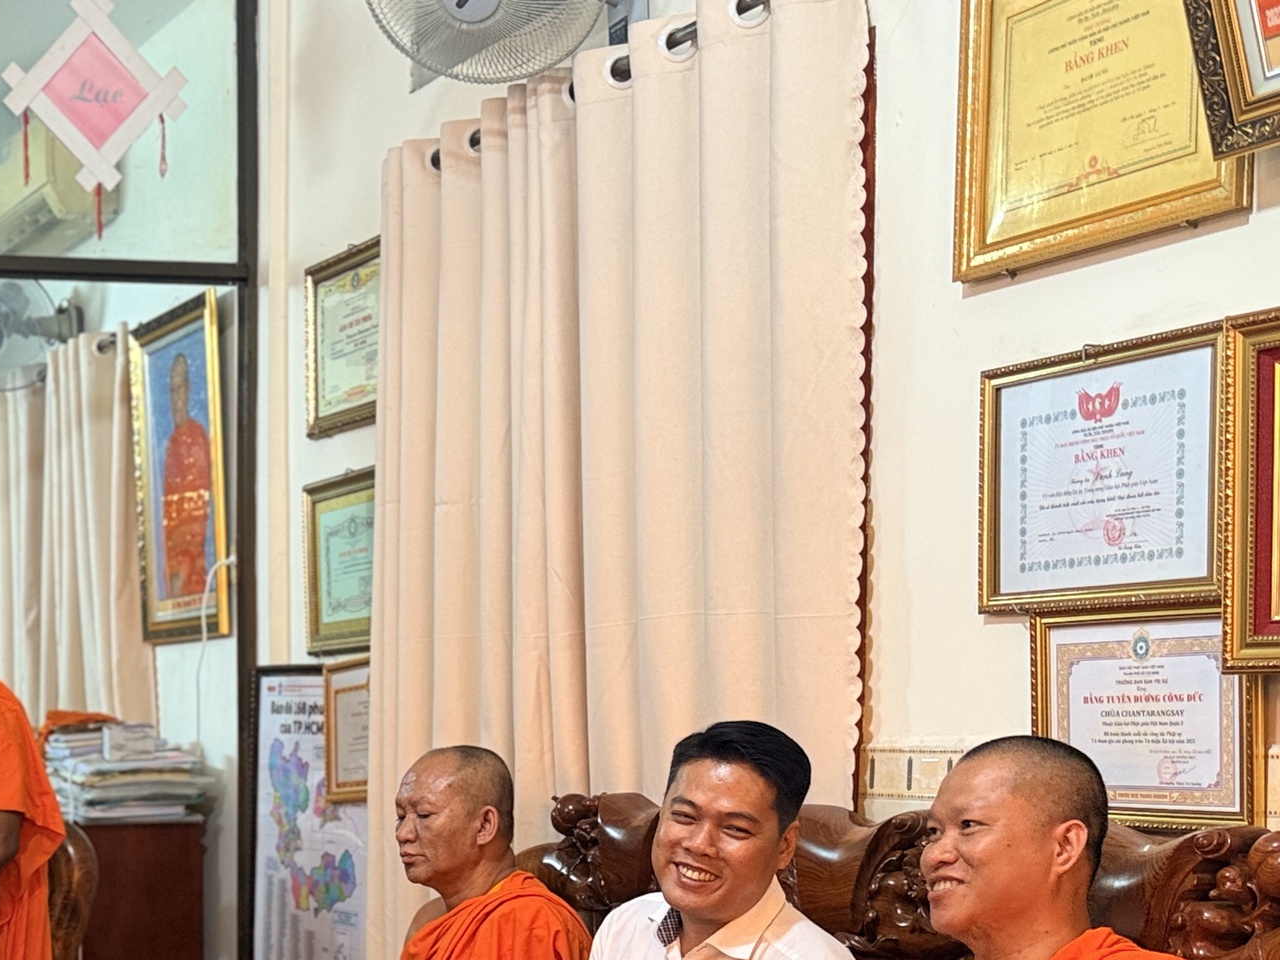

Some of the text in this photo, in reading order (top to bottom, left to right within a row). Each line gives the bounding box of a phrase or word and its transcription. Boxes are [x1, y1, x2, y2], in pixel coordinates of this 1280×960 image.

[1065, 51, 1094, 73] BẰNG
[1097, 37, 1130, 61] KHEN
[1074, 446, 1125, 464] BẰNG KHEN
[1083, 691, 1104, 705] BẰNG
[1133, 692, 1161, 704] DƯƠNG
[1162, 691, 1185, 703] CÔNG
[294, 700, 307, 715] 168
[1121, 709, 1185, 718] CHANTARANGSAY
